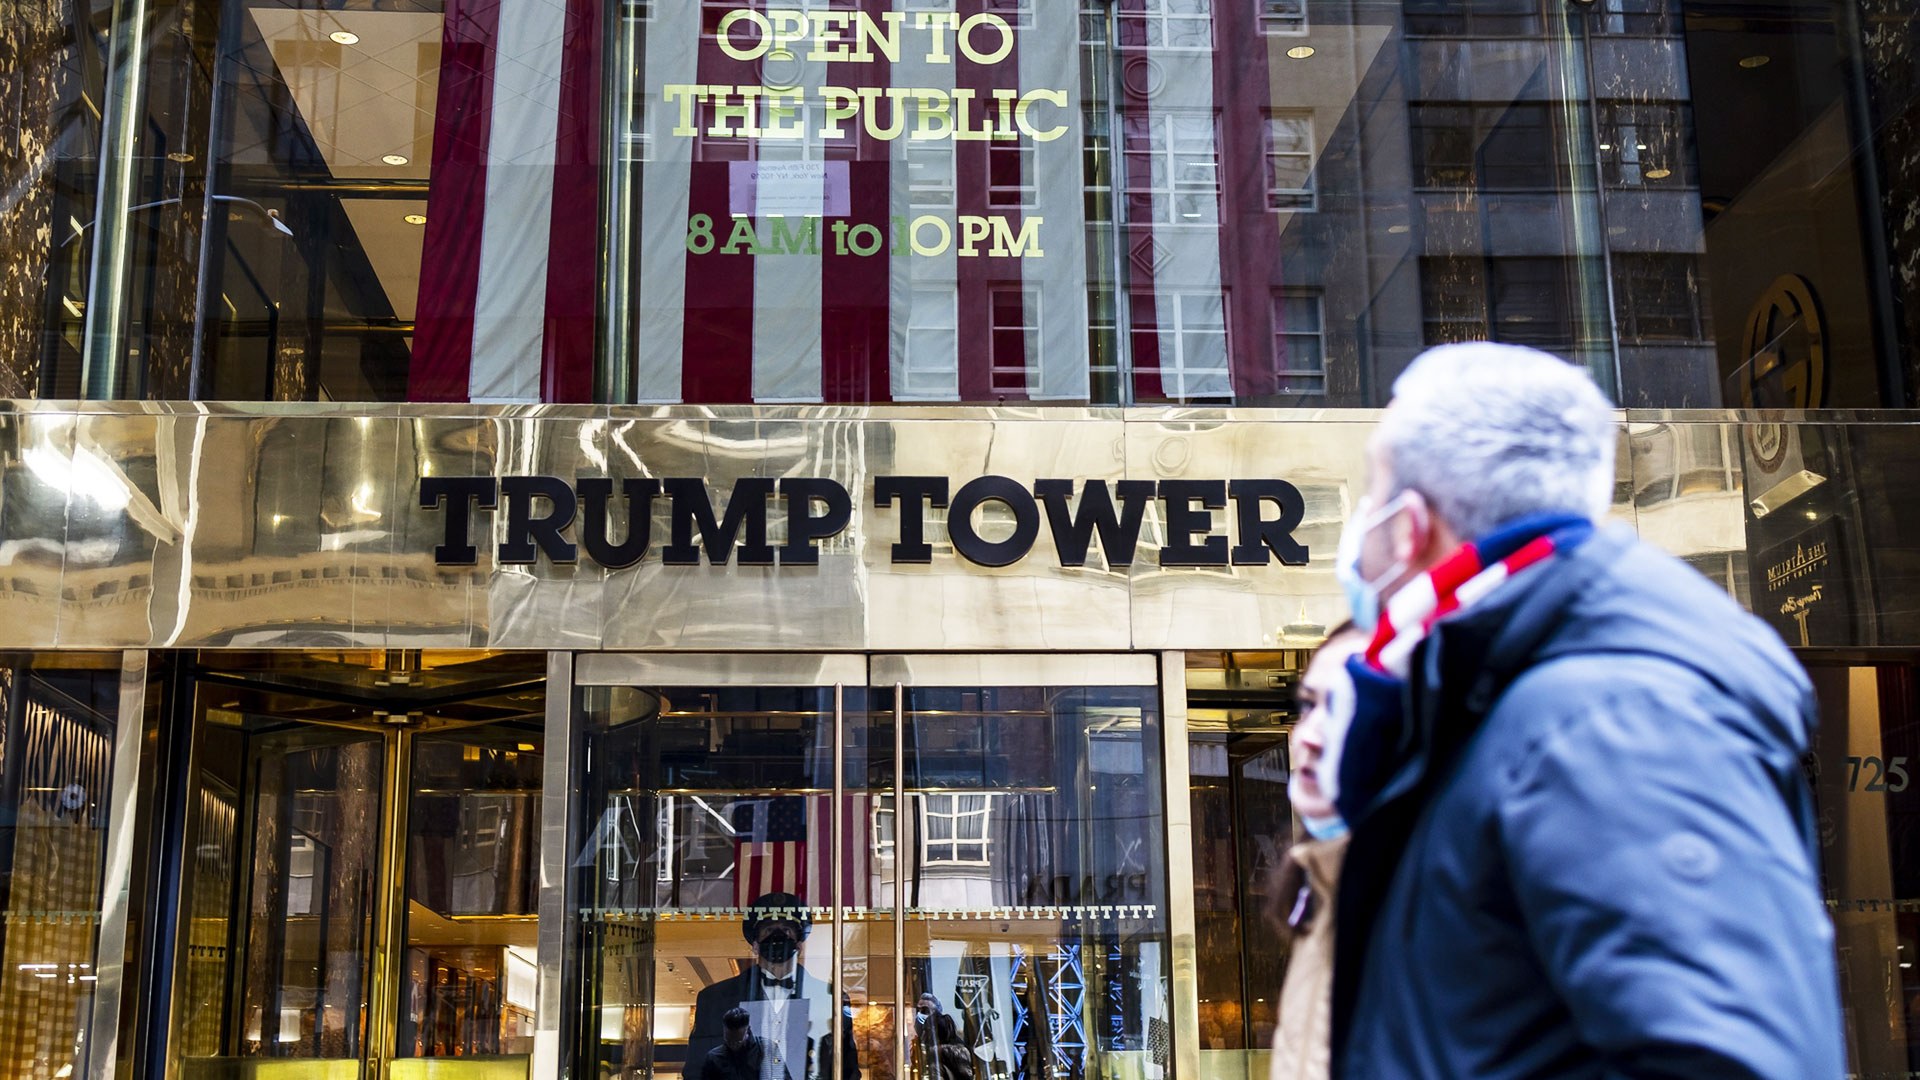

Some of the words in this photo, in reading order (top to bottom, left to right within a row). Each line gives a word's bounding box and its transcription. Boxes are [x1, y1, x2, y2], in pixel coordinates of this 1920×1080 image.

[716, 9, 906, 63] OPEN
[915, 11, 1014, 65] TO
[664, 84, 805, 139] THE
[818, 86, 1069, 142] PUBLIC
[686, 213, 714, 255] 8
[720, 213, 822, 255] AM
[832, 217, 883, 257] to
[891, 215, 951, 257] 10
[958, 215, 1044, 258] PM
[419, 475, 853, 570] TRUMP
[874, 475, 1310, 568] TOWER
[1843, 756, 1909, 793] 725
